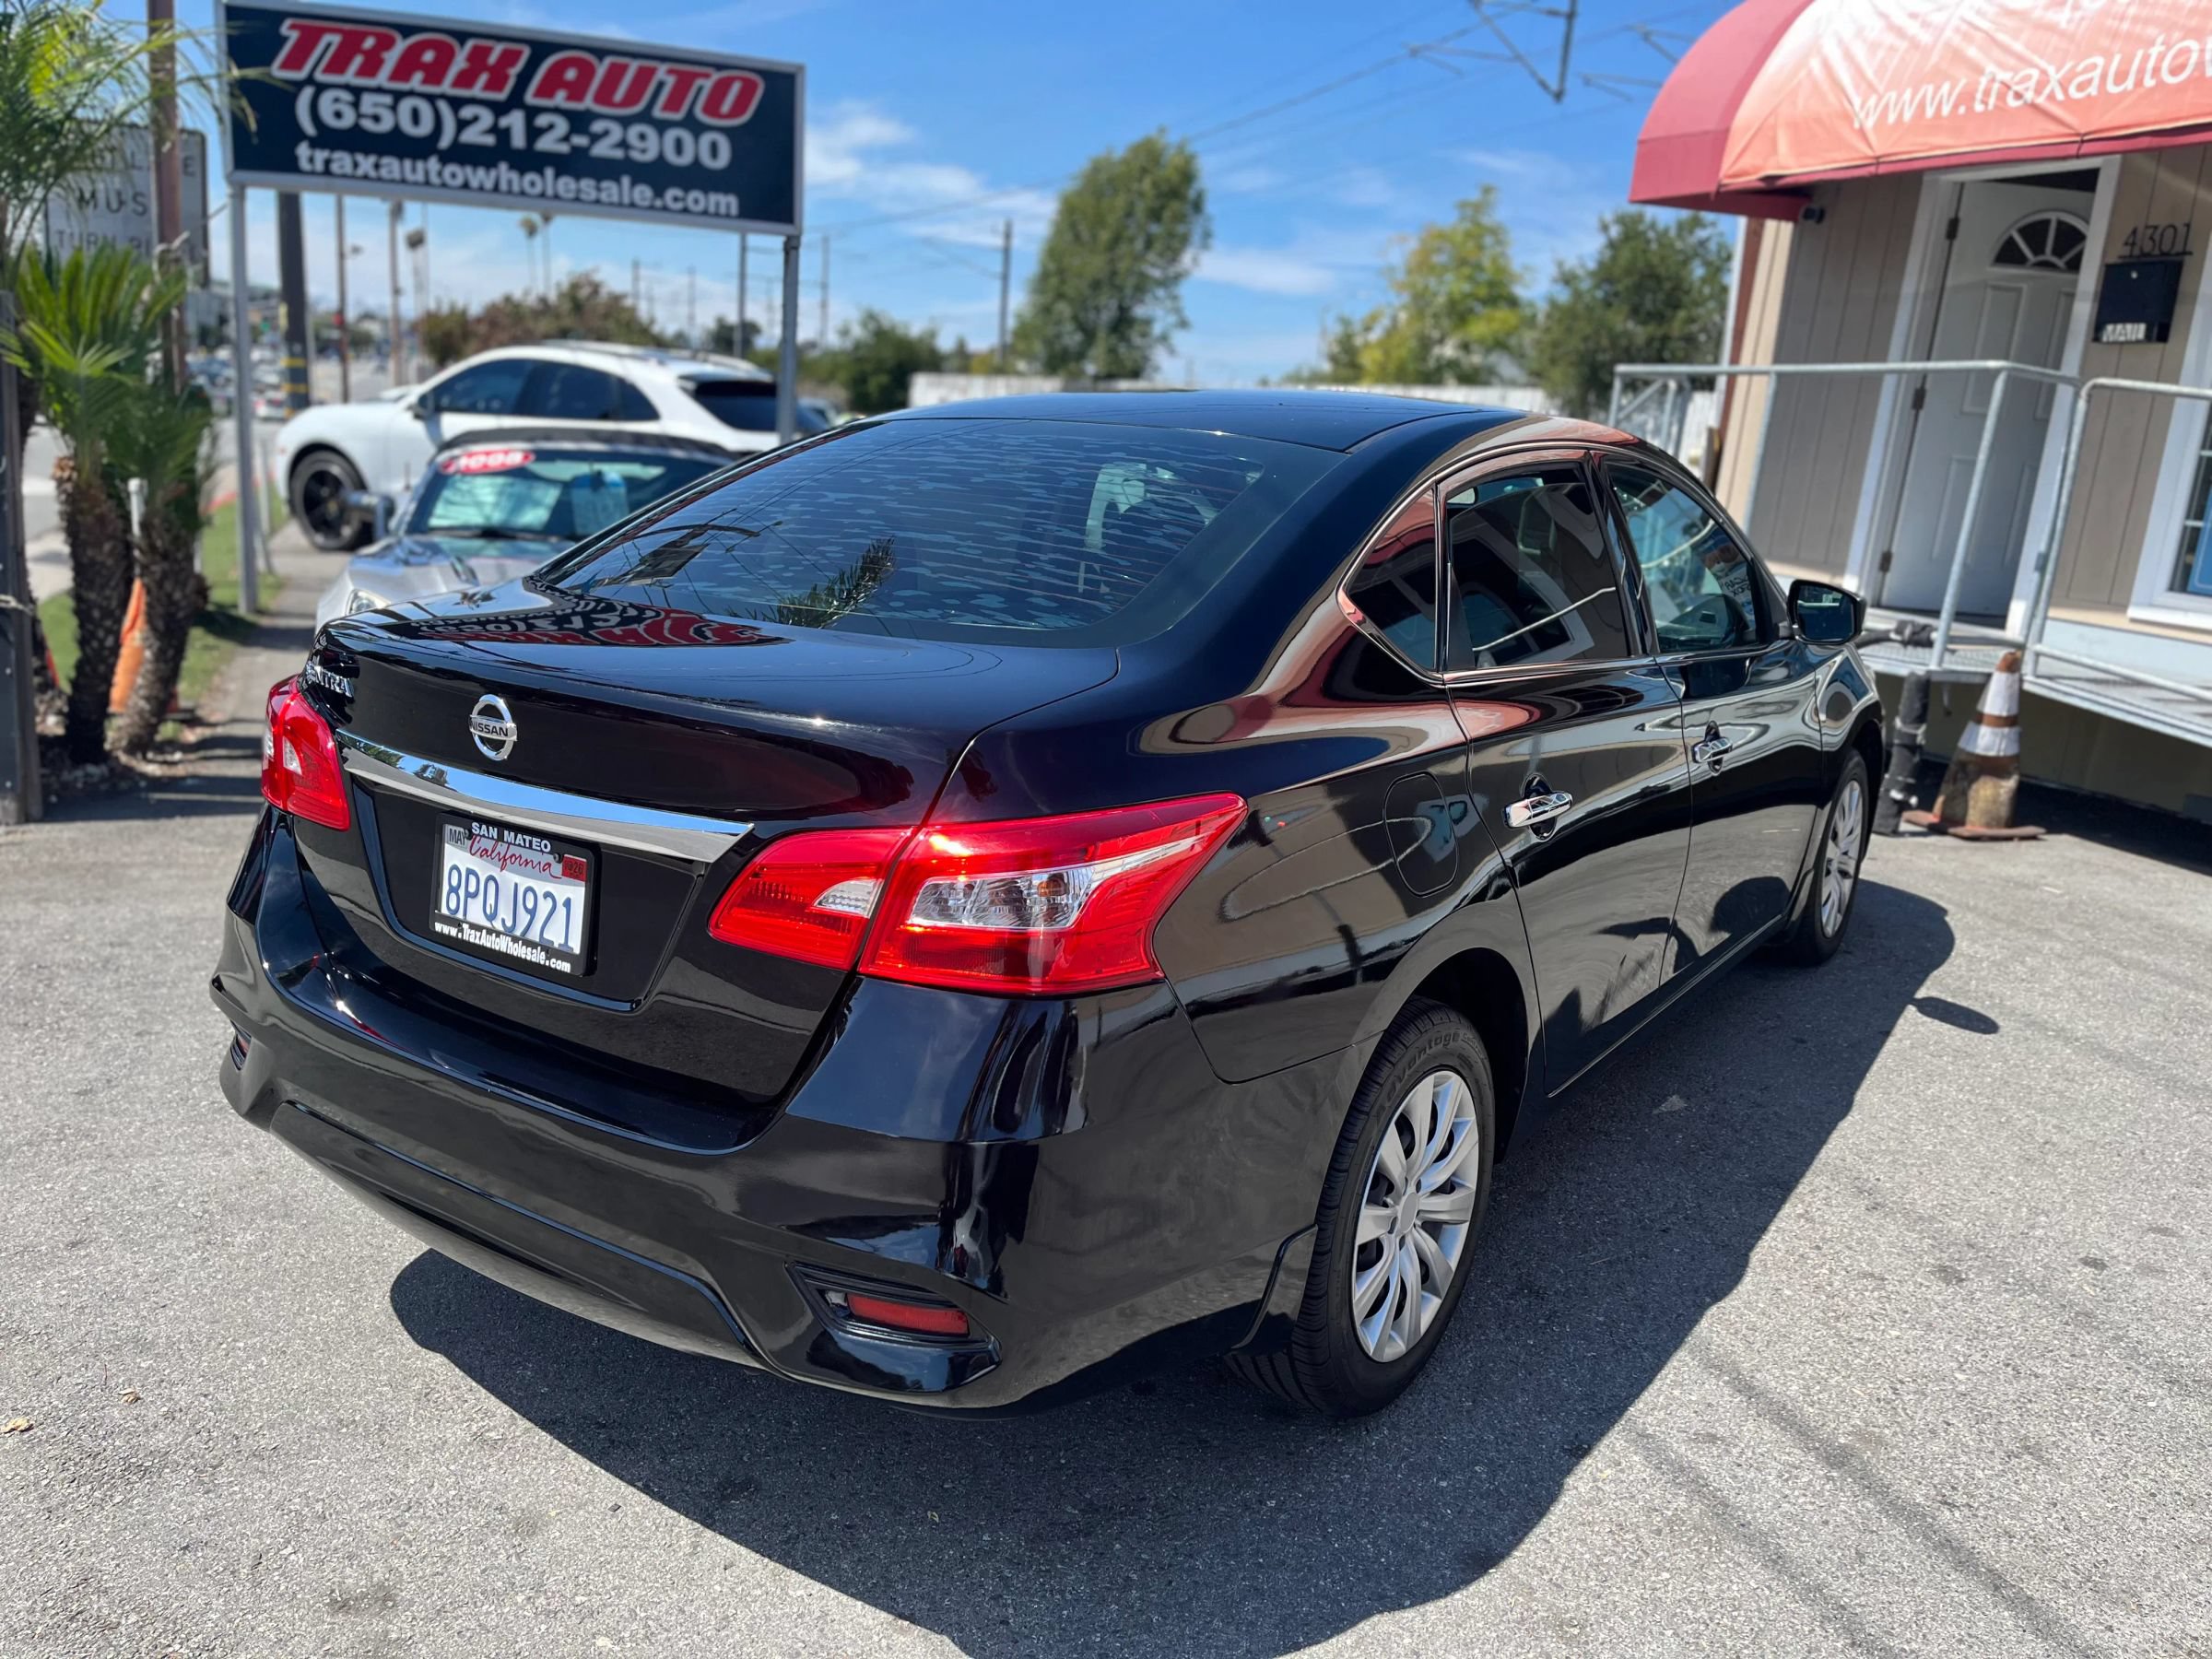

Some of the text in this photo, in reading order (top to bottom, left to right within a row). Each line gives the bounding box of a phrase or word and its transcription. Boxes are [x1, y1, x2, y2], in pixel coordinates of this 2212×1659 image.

[272, 18, 765, 127] TRAX AUTO
[1853, 34, 2212, 129] www.traxauto
[295, 85, 732, 171] (650)212-2900
[295, 140, 739, 217] traxautowholesale.com
[77, 187, 148, 217] MUS
[2119, 222, 2193, 258] 4301
[2102, 323, 2147, 343] MAIL
[469, 720, 509, 737] NISSAN
[449, 827, 466, 846] MAY
[468, 835, 562, 879] California
[471, 821, 551, 853] SAN MATEO
[445, 864, 574, 952] 8PQJ921
[434, 922, 571, 973] www.TraxAutoWholesale.com
